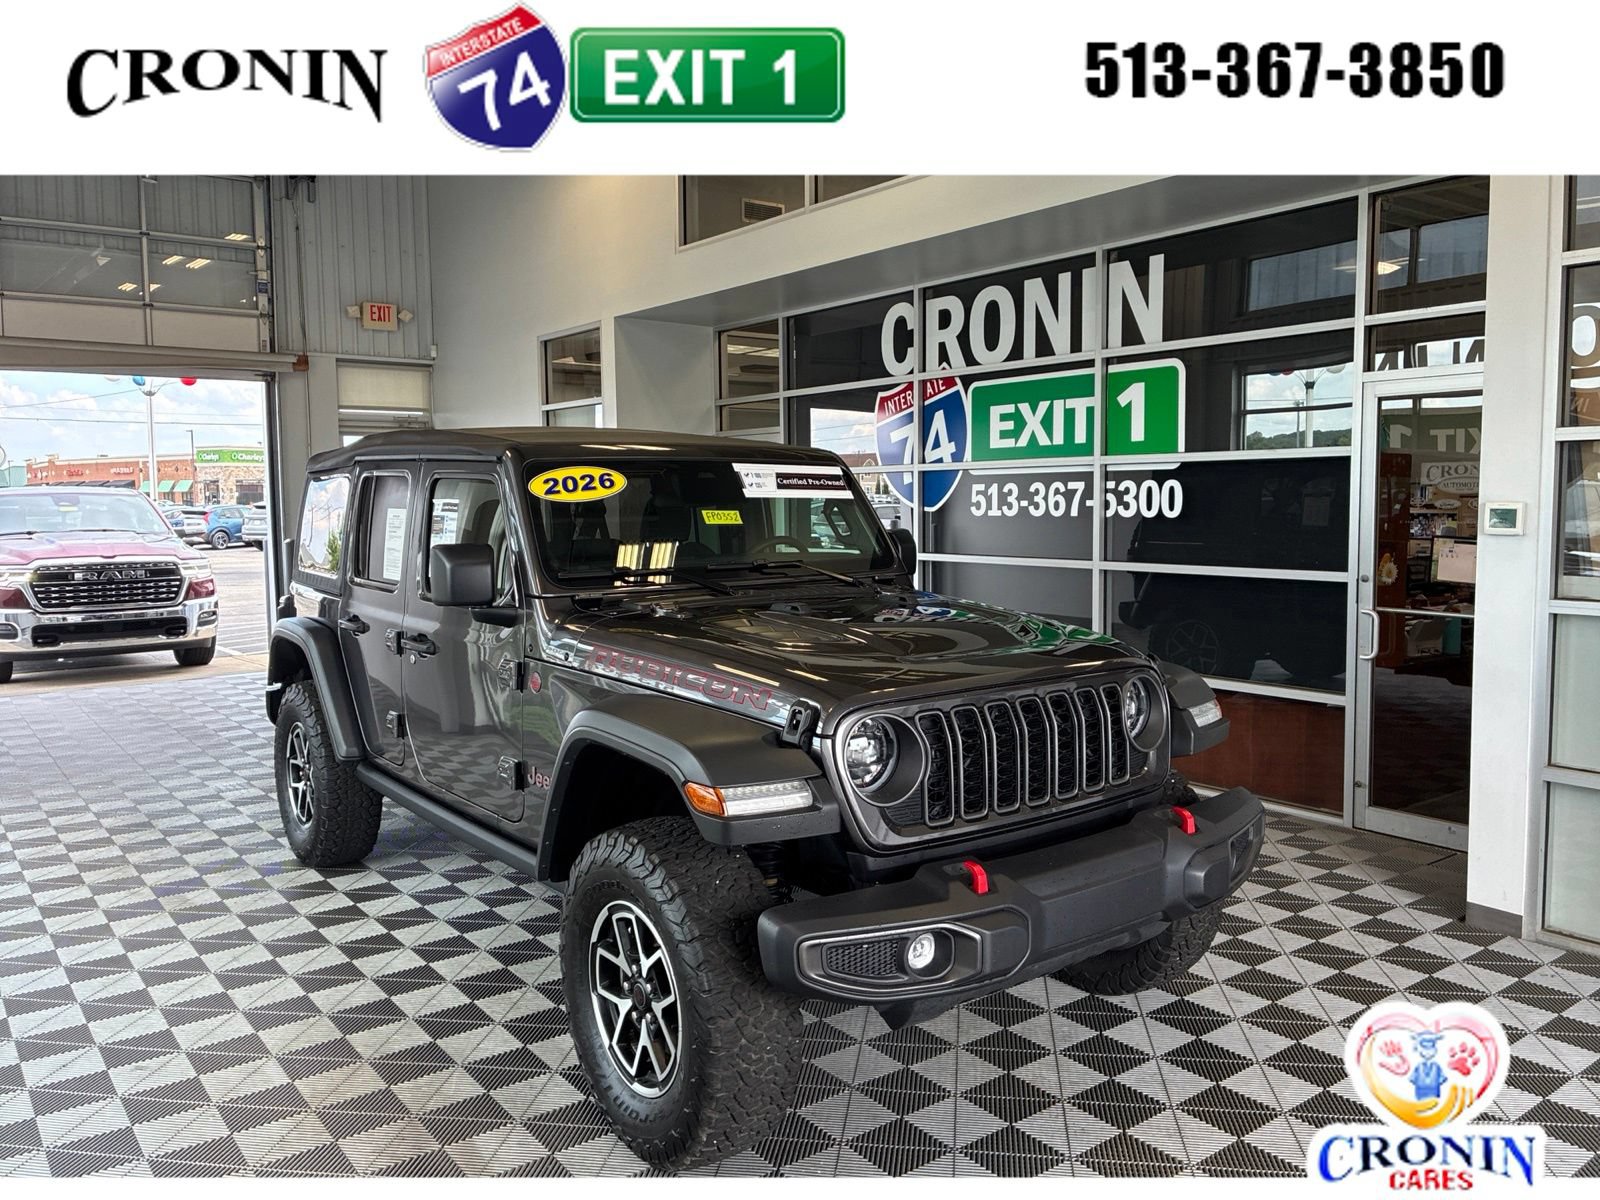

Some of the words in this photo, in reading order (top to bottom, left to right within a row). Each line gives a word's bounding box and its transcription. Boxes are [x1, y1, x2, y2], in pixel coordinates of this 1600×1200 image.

[369, 304, 391, 322] EXIT
[881, 254, 1165, 376] CRONIN
[884, 379, 947, 416] INTERATE
[989, 396, 1095, 449] EXIT
[1116, 382, 1146, 442] 1
[889, 408, 956, 485] 74
[543, 472, 615, 495] 2026
[777, 477, 807, 486] Certified
[808, 477, 845, 487] Pre-Owned
[970, 478, 1183, 519] 513-367-5300
[74, 569, 145, 580] RAM
[588, 643, 773, 711] RUBICON
[528, 766, 552, 790] Jee
